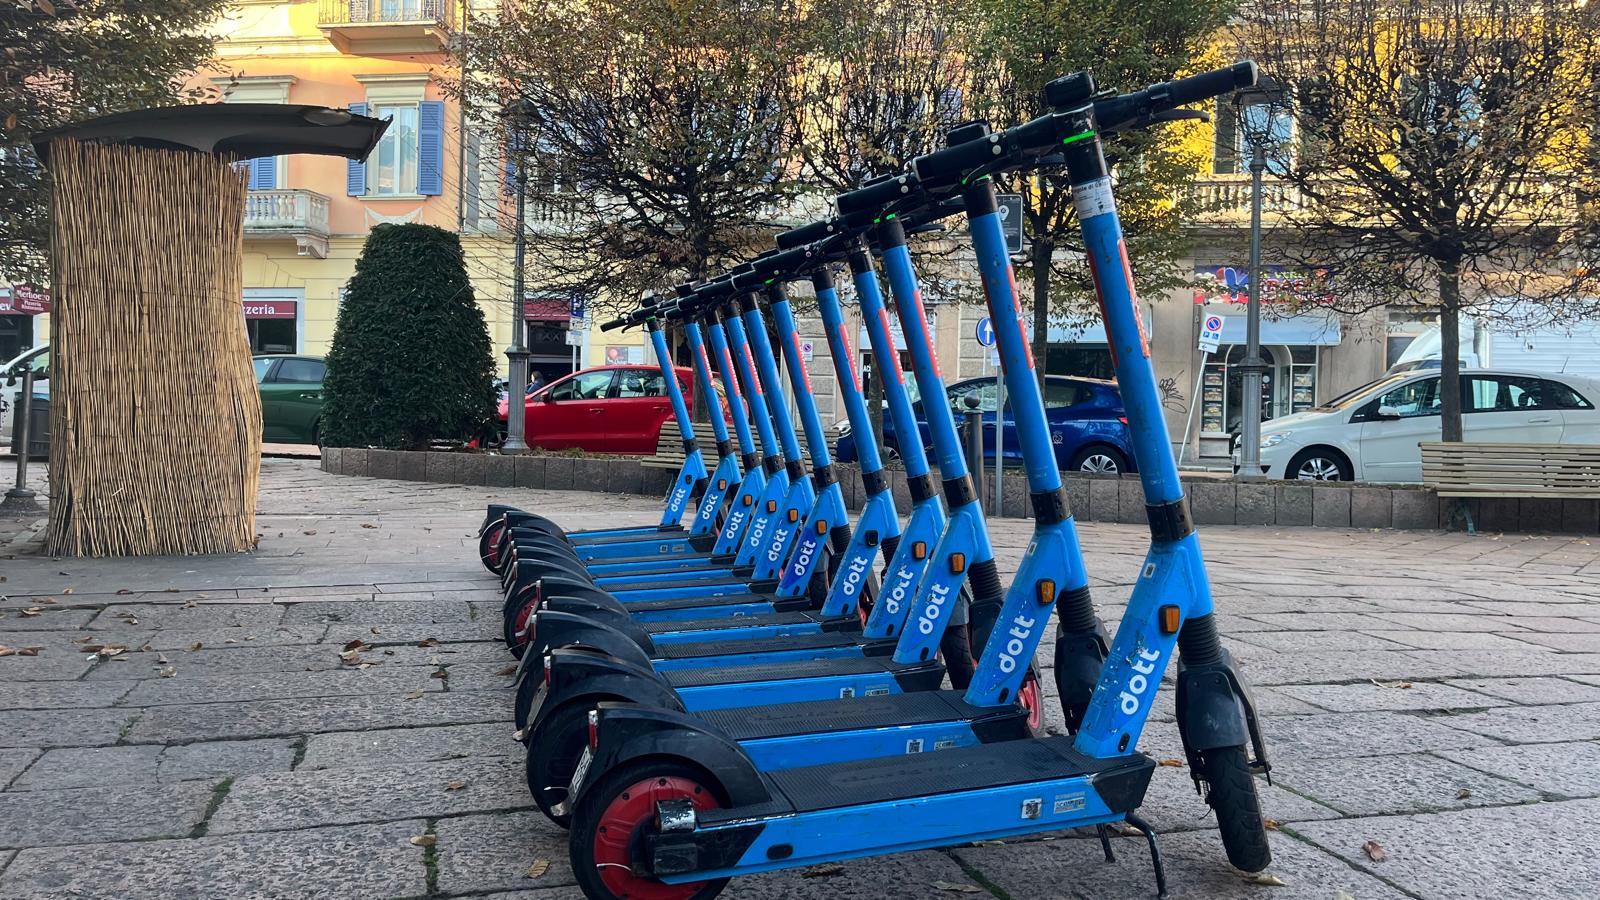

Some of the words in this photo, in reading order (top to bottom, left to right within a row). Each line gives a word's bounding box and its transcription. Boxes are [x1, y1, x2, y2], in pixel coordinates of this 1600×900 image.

[671, 489, 686, 513] dott
[702, 494, 718, 520] dott
[726, 510, 745, 539] dott
[750, 517, 768, 547] dott
[768, 528, 788, 562] dott
[795, 540, 816, 576] dott
[843, 556, 868, 595] dott
[886, 564, 914, 614] dott
[918, 583, 950, 634] dott
[998, 615, 1036, 674] dott
[1119, 646, 1162, 716] dott
